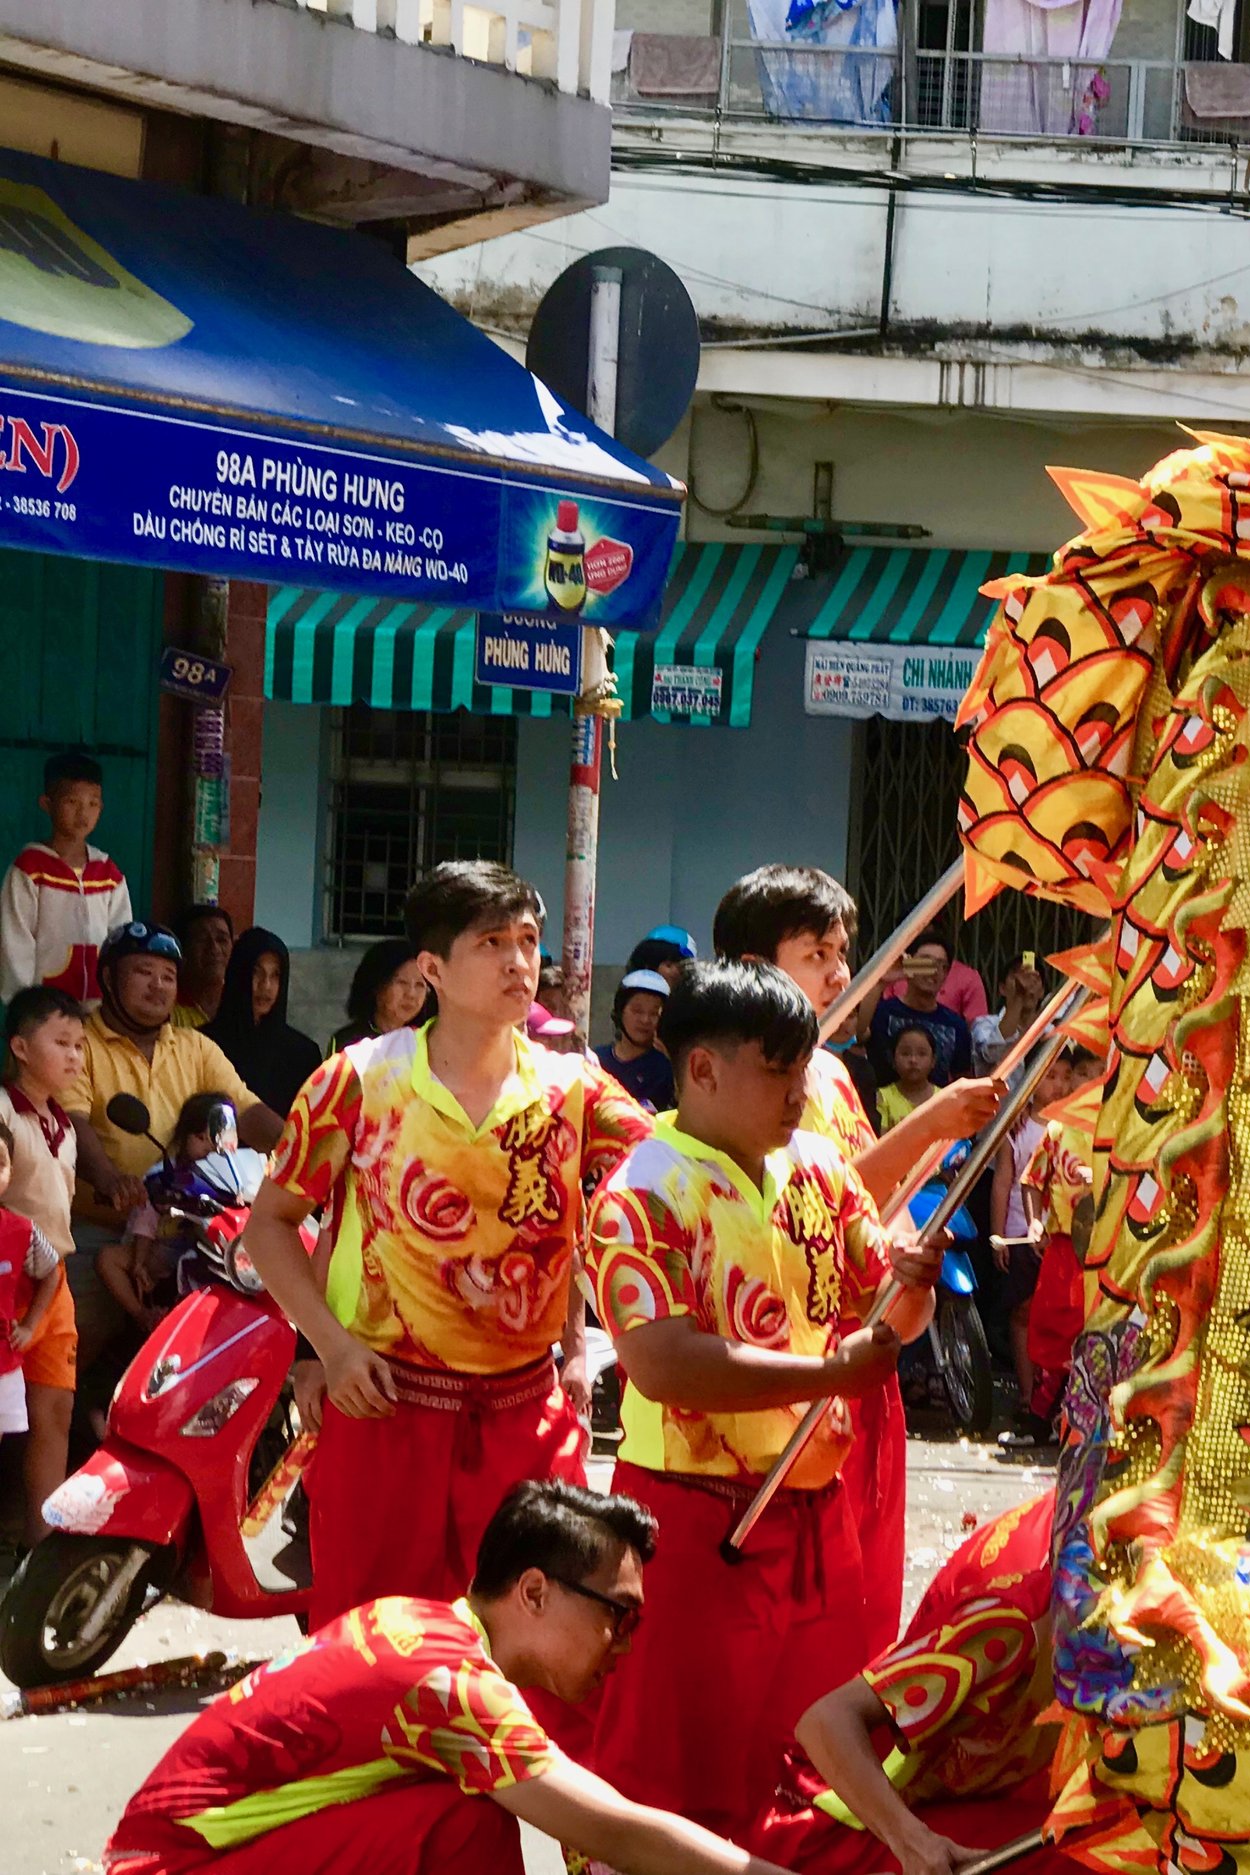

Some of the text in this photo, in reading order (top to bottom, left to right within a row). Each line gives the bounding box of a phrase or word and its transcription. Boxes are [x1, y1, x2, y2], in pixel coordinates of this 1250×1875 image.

[216, 450, 405, 513] 98A PHÙNG HƯNG
[13, 496, 77, 522] 38536 708
[169, 485, 232, 517] CHUYÊN
[236, 493, 268, 522] BÁN
[271, 499, 302, 528] CÁC
[306, 508, 340, 538] LOẠI
[343, 514, 374, 540] SƠN
[386, 521, 415, 546] KEO
[133, 509, 166, 540] DẦU
[170, 517, 226, 549] CHỐNG
[248, 527, 277, 556] SÉT
[280, 535, 292, 559] &
[362, 548, 381, 572] ĐA
[384, 549, 422, 578] NĂNG
[425, 557, 468, 585] WD-40
[548, 560, 584, 586] WD-40
[171, 657, 217, 685] 98A
[484, 631, 571, 676] PHÙNG HƯNG
[903, 657, 924, 688] CHI
[928, 652, 973, 689] NHÁNH
